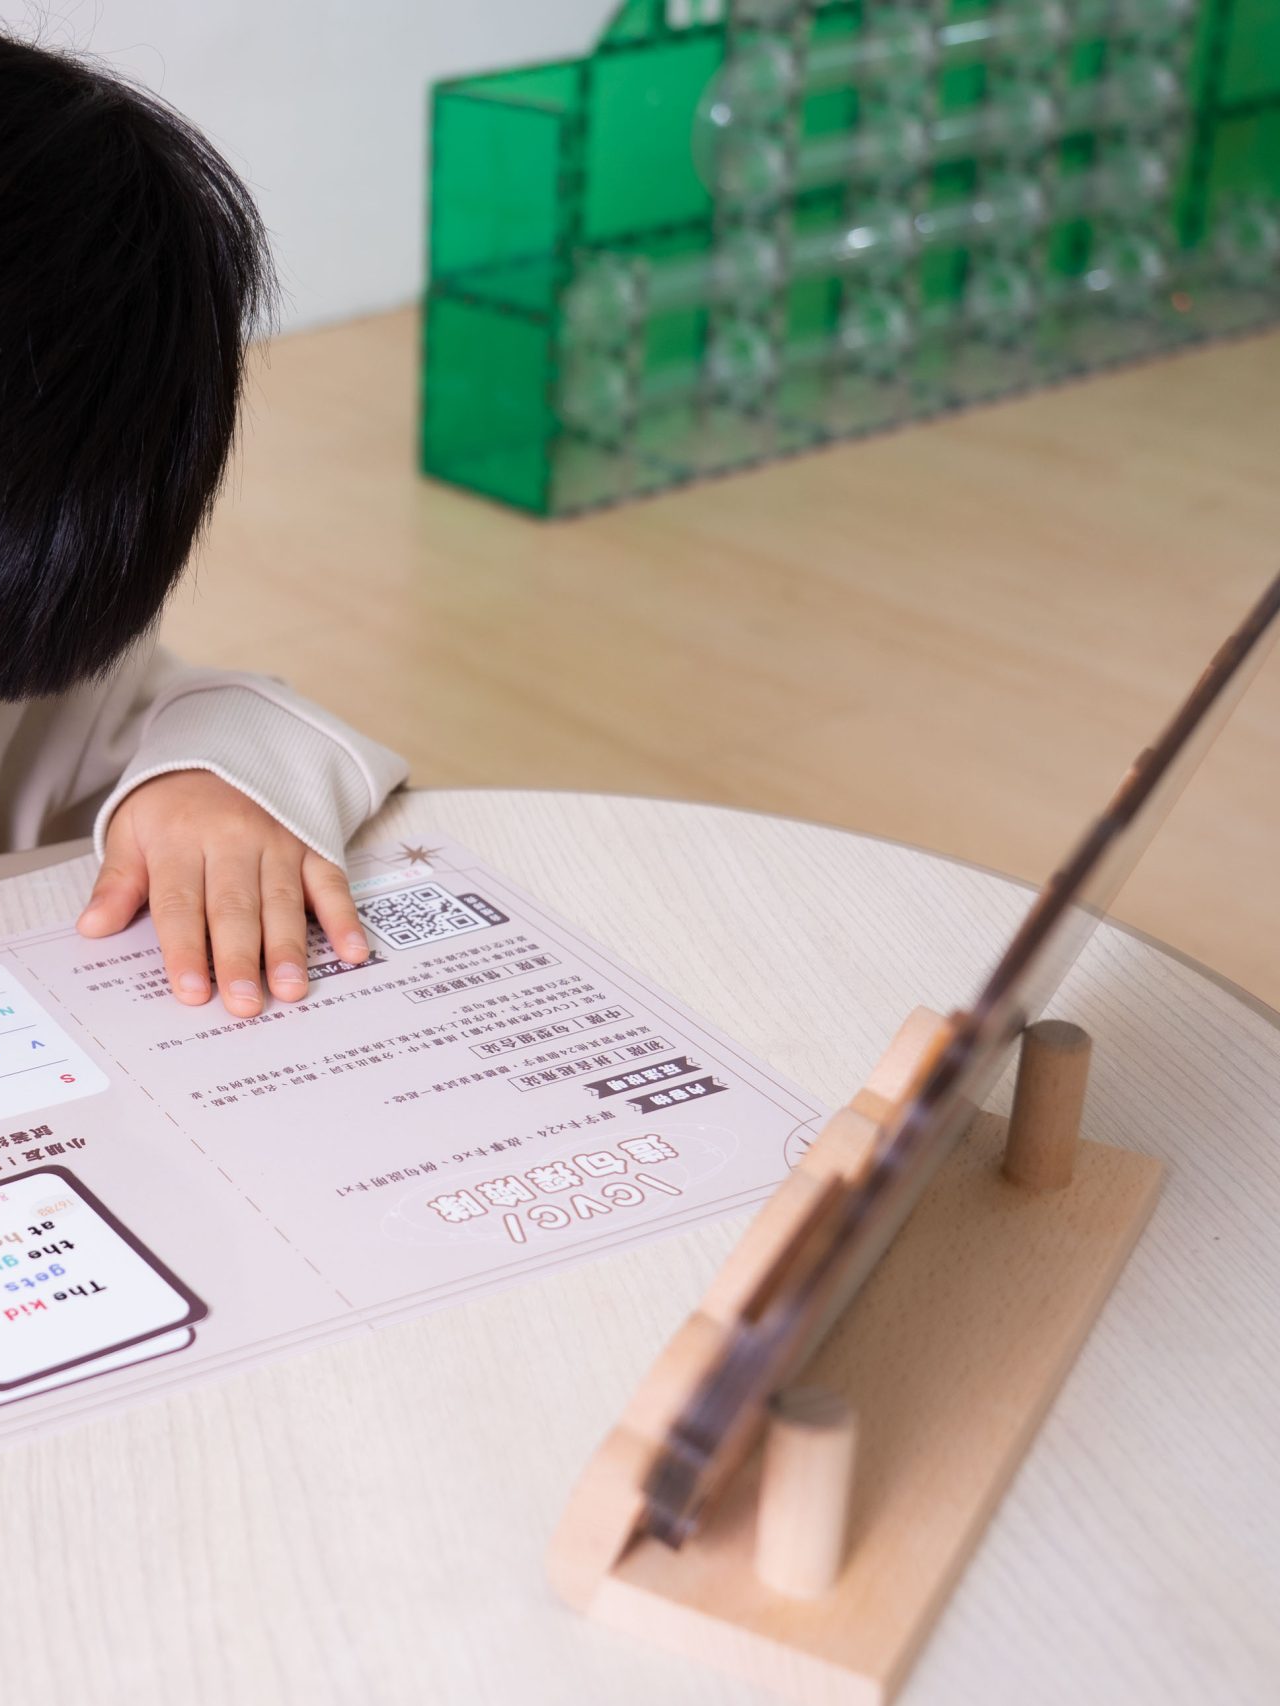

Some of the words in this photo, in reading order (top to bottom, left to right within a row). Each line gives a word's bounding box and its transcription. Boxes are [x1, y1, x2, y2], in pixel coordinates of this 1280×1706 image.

[31, 1039, 45, 1049] V
[59, 1073, 75, 1083] S
[606, 1063, 681, 1090] 玩法說明
[649, 1083, 706, 1105] 內容物
[425, 1133, 679, 1224] 造句探險隊
[26, 1220, 55, 1236] at
[26, 1239, 74, 1259] the
[4, 1263, 65, 1291] gets
[52, 1280, 107, 1301] The
[3, 1298, 47, 1321] kid
